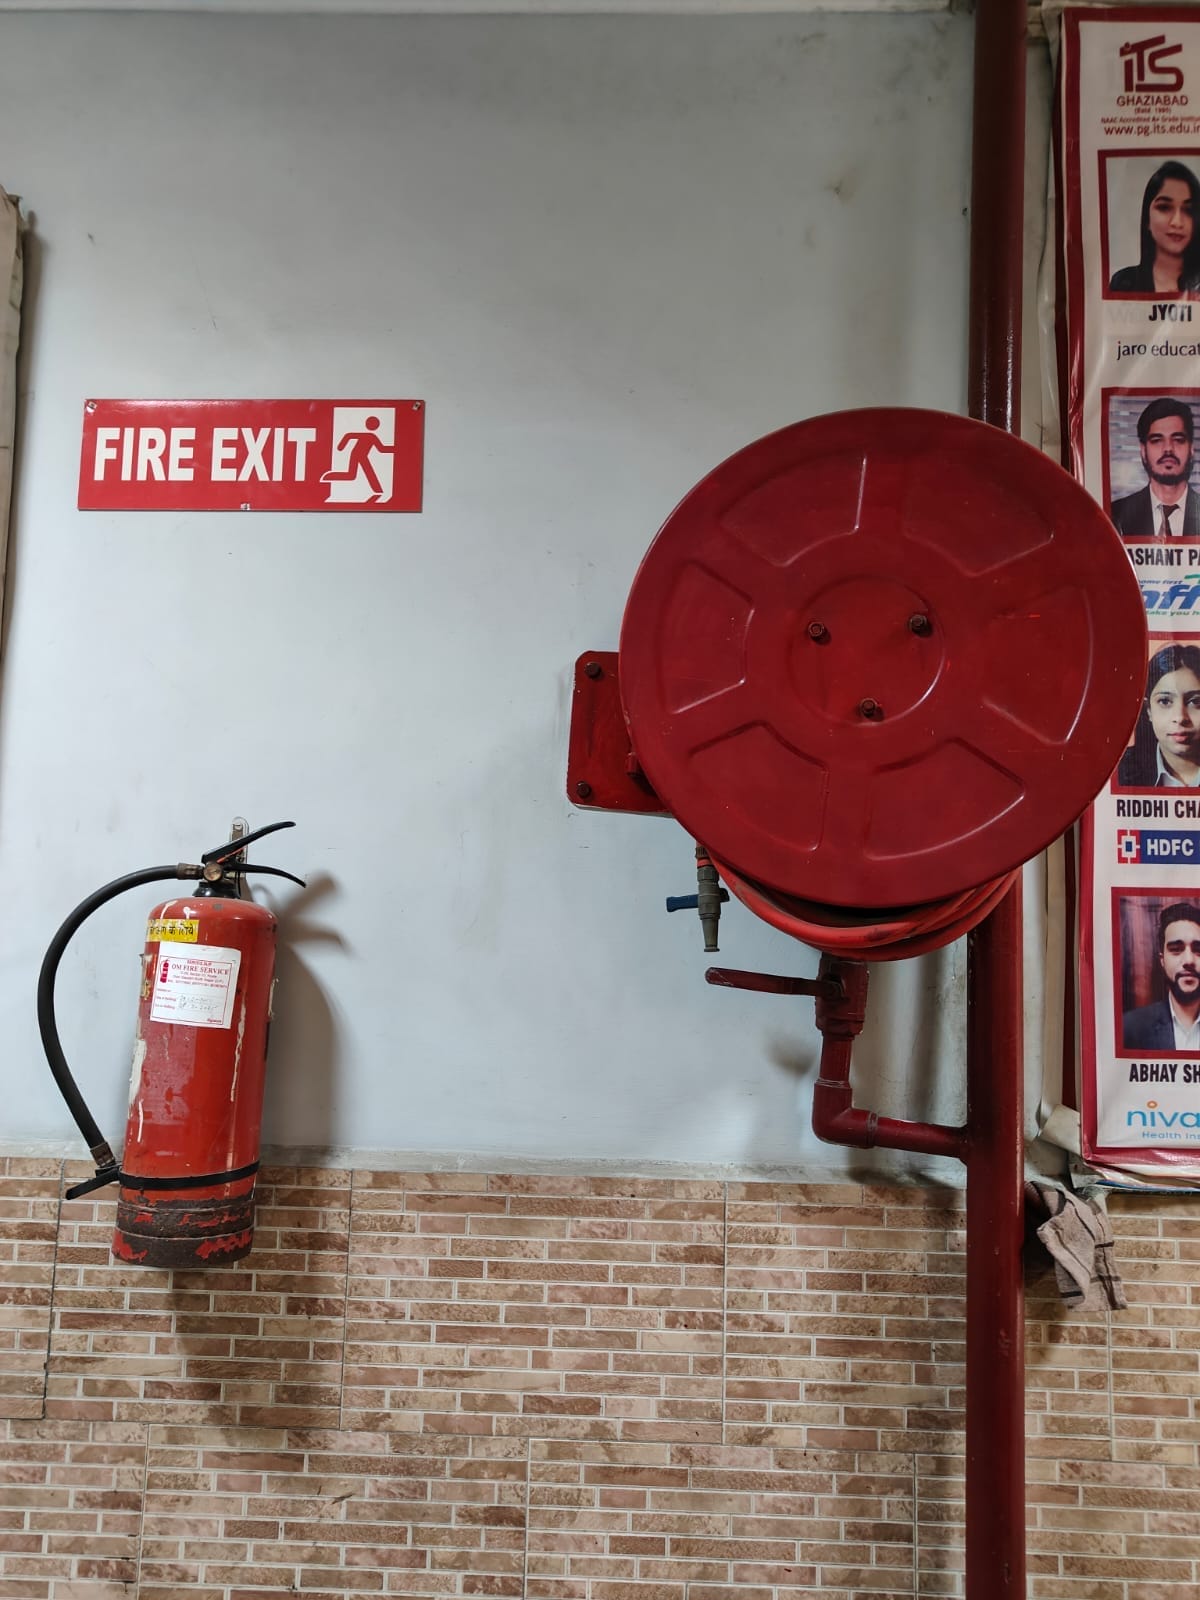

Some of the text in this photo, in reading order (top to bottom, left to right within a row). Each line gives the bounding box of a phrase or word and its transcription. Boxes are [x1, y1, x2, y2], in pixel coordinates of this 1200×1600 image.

[1116, 95, 1189, 106] GHAZIABAD
[1148, 303, 1192, 322] JYOTI
[1116, 340, 1147, 361] jaro
[93, 427, 317, 482] FIRE EXIT
[1116, 799, 1168, 818] RIDDHI
[1146, 838, 1194, 856] HDFC
[183, 964, 199, 972] FIRE
[200, 966, 229, 976] SERVICE
[1129, 1063, 1178, 1082] ABHAY
[1142, 1131, 1181, 1139] Health
